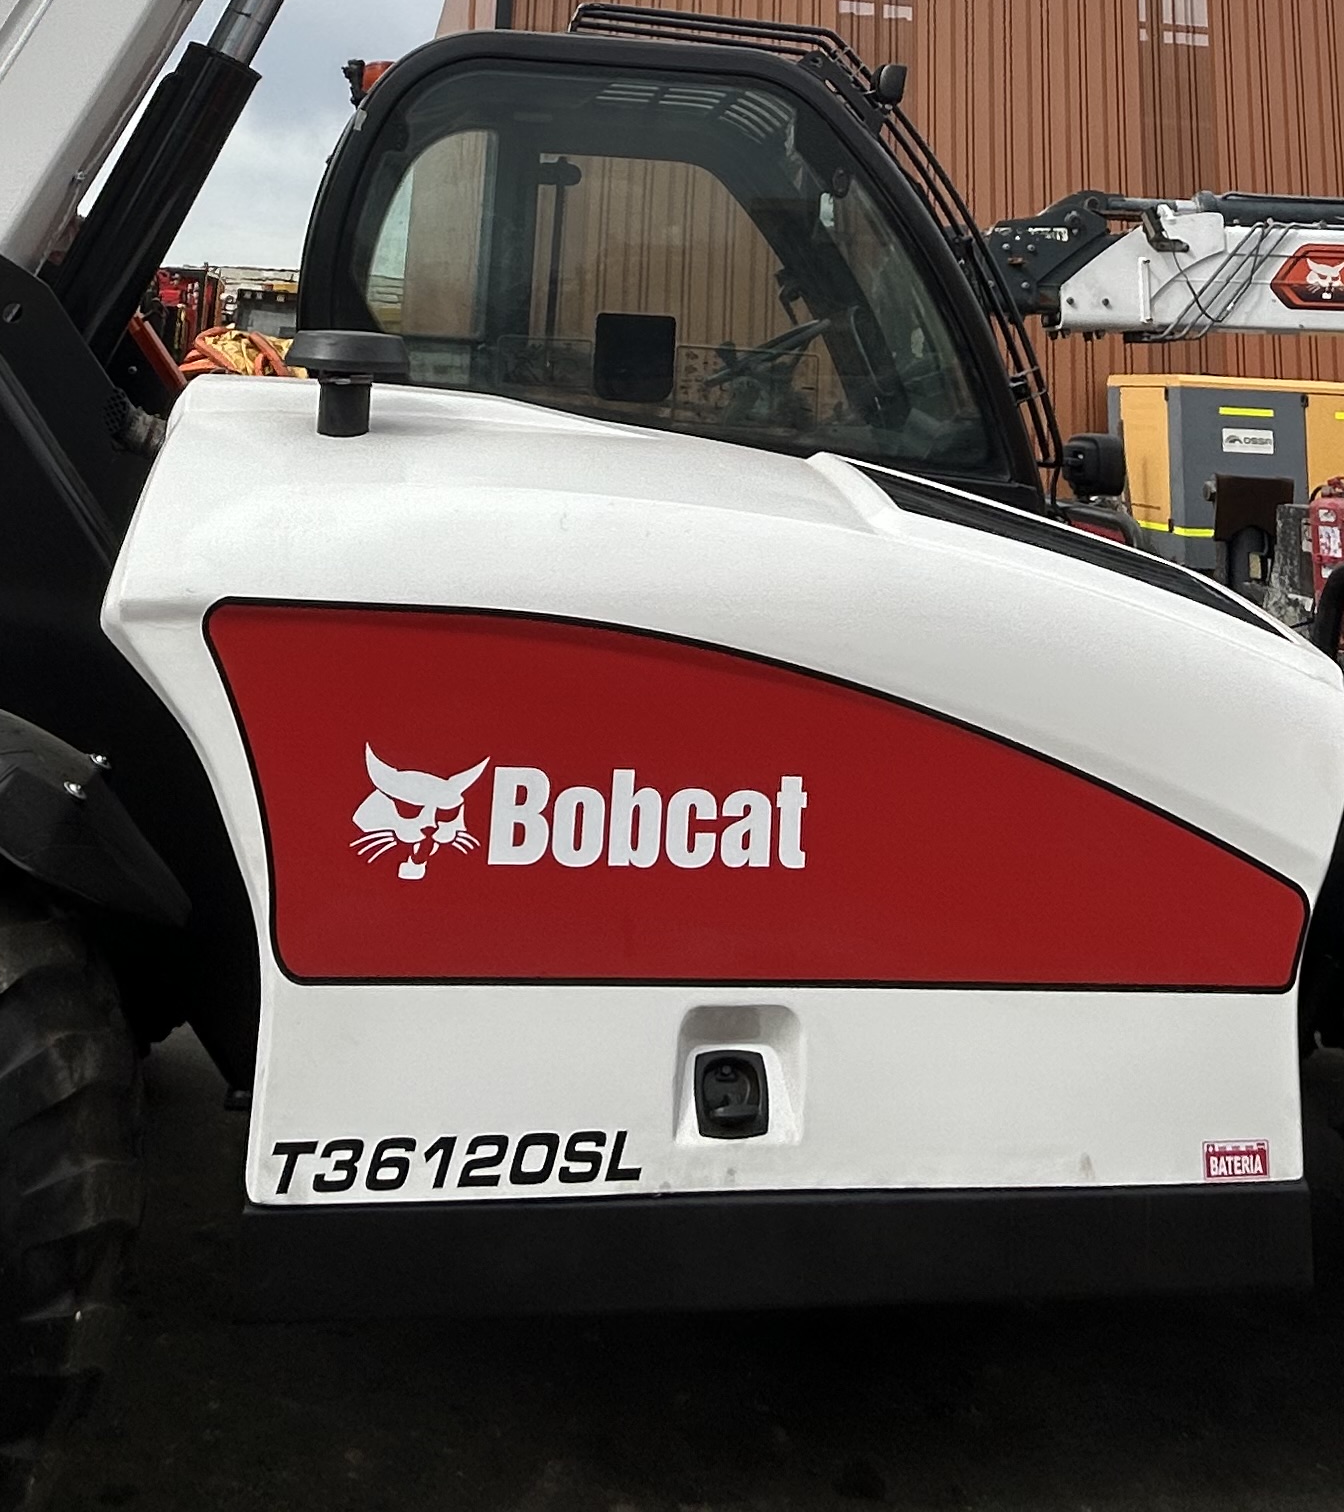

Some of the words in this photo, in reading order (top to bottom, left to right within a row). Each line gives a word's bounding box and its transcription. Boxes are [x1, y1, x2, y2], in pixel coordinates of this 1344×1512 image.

[487, 765, 808, 869] Bobcat
[271, 1130, 642, 1196] T36120SL
[1209, 1154, 1263, 1176] BATERIA
